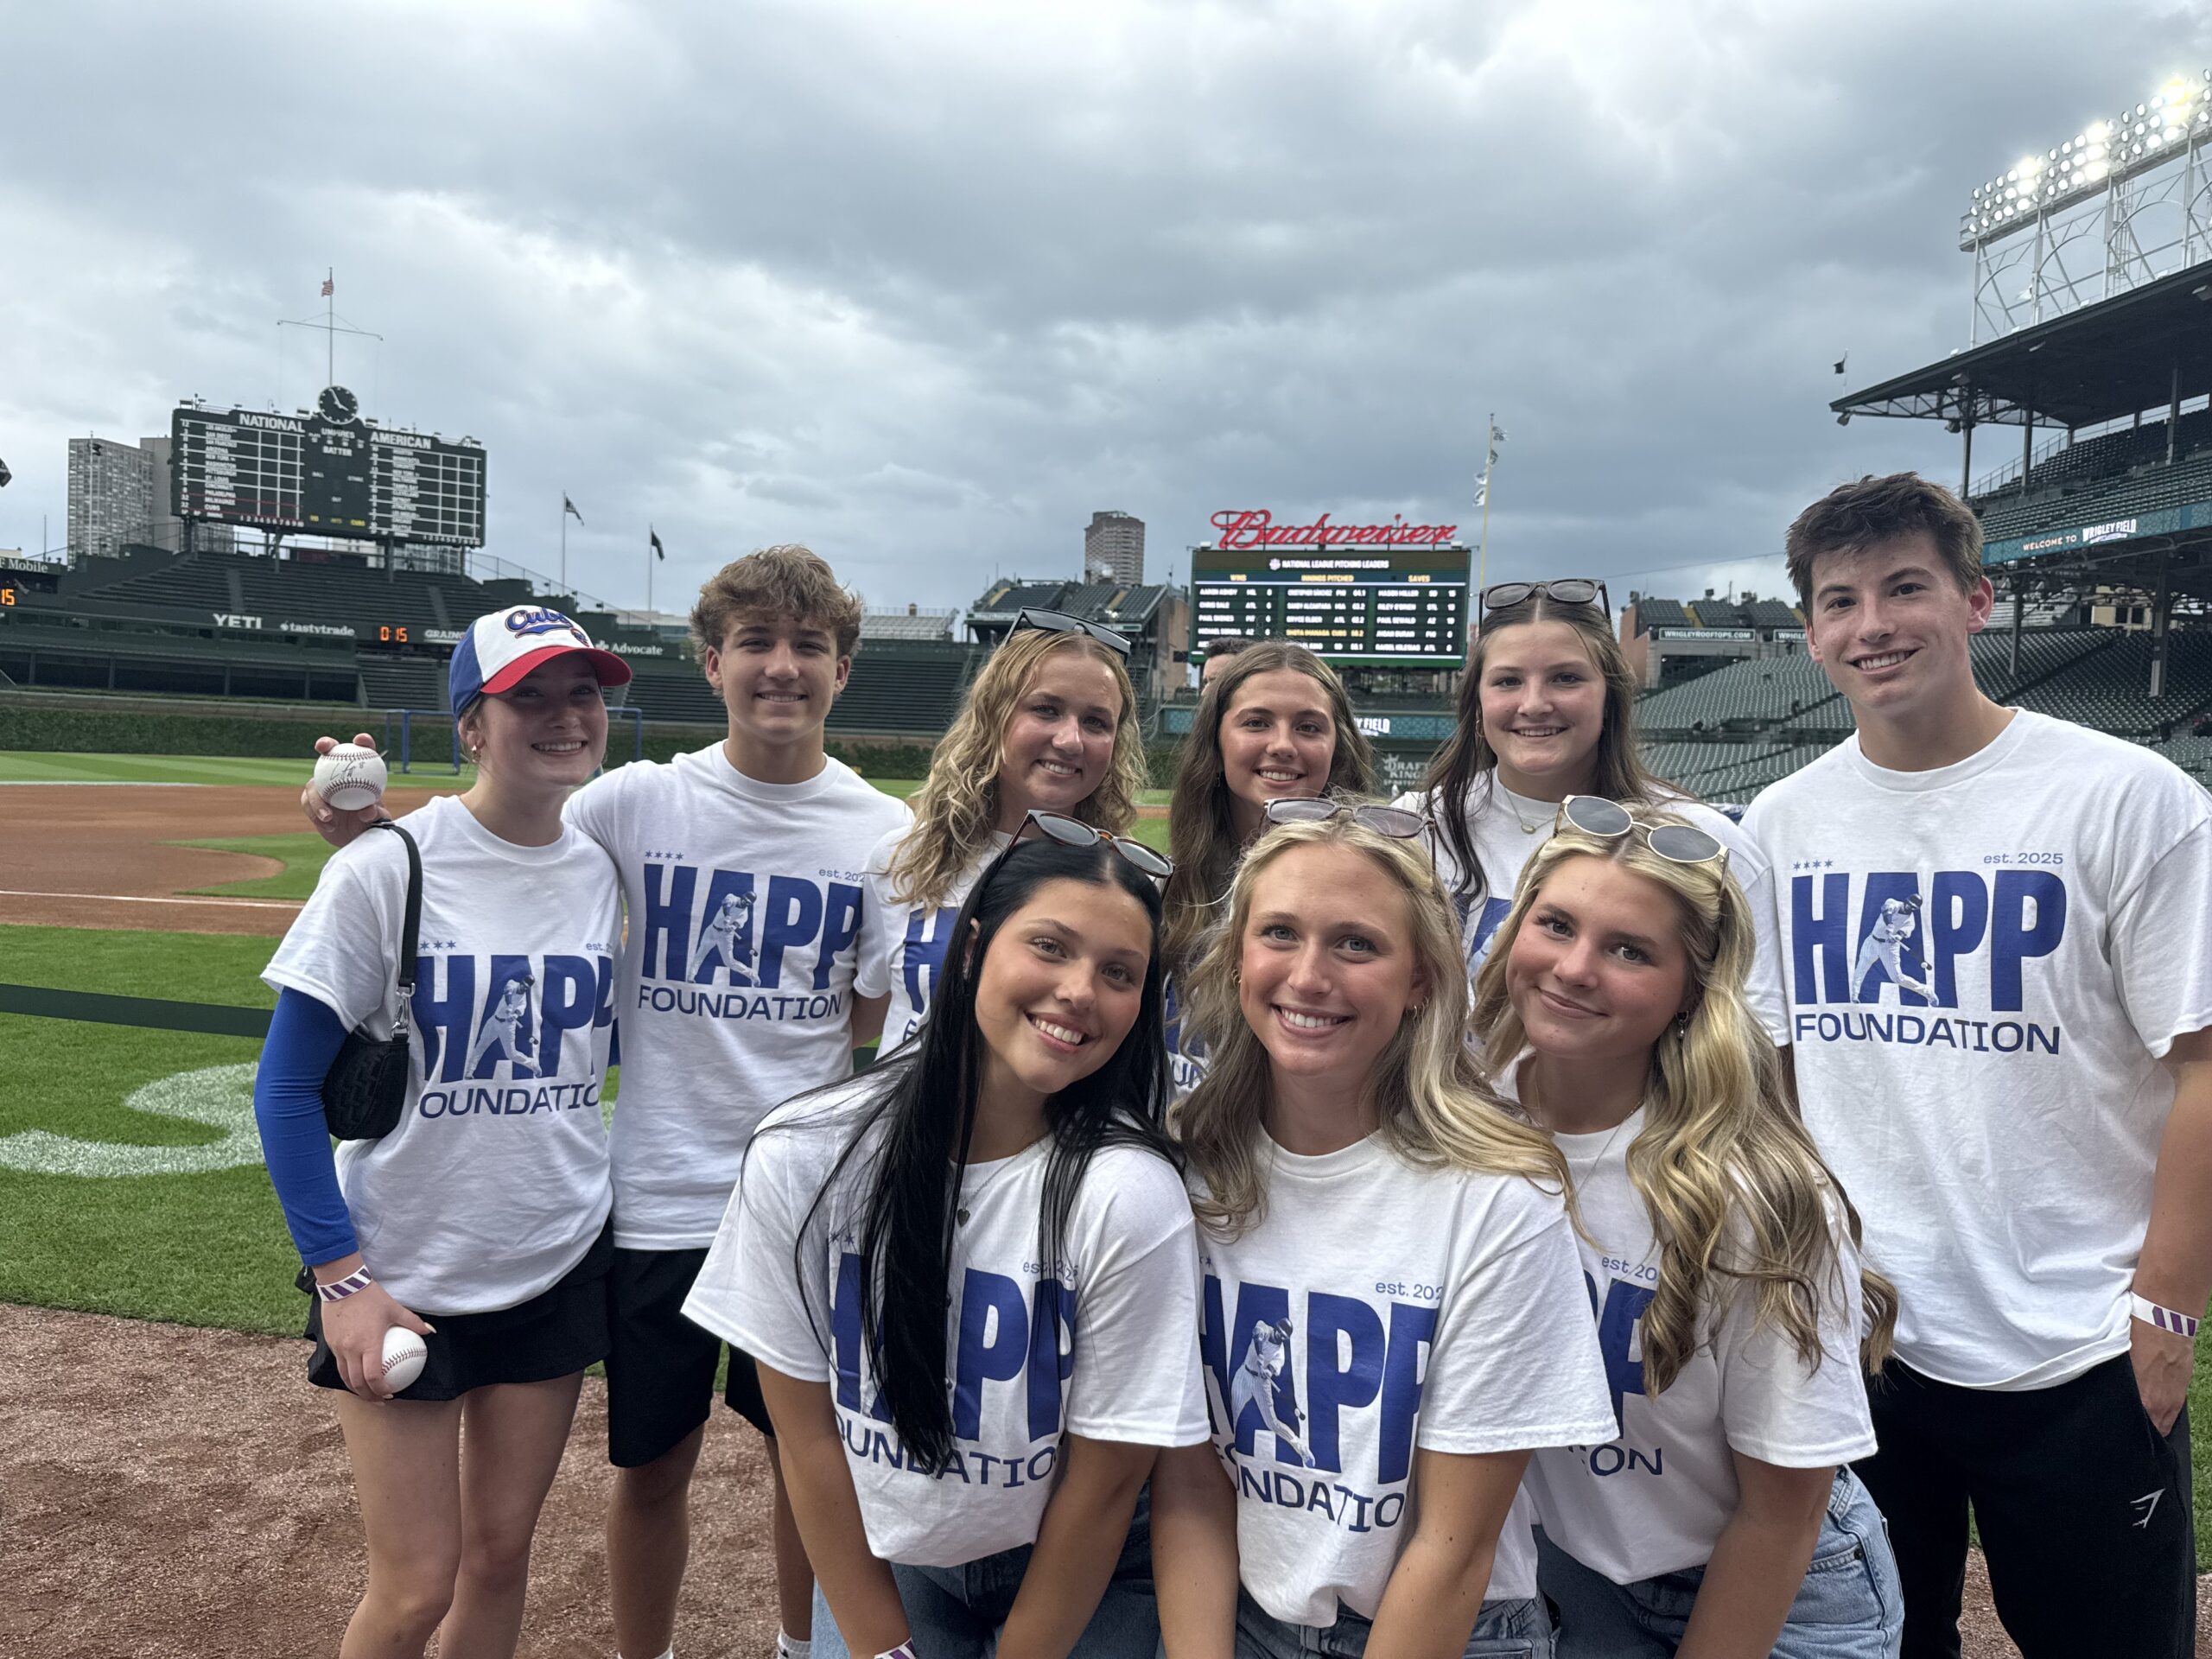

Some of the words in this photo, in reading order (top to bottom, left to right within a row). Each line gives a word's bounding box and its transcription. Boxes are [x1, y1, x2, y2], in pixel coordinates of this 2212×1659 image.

[239, 413, 305, 433] NATIONAL
[370, 431, 431, 449] AMERICAN
[322, 446, 353, 457] BATTER
[1211, 509, 1457, 550] Budweiser
[2023, 537, 2063, 551] WELCOME
[2065, 534, 2077, 543] TO
[2082, 522, 2115, 542] WRIGLEY
[2116, 518, 2137, 533] FIELD
[8, 558, 48, 574] Mobile
[1, 588, 15, 606] 15
[213, 613, 262, 629] YETI
[289, 622, 355, 637] tastytrade
[379, 626, 408, 642] 0:15
[1664, 630, 1751, 639] WRIGLEYROOFTOPS.COM
[612, 643, 663, 656] Advocate
[1363, 717, 1390, 734] FIELD
[1984, 854, 2012, 865] est.
[2018, 852, 2063, 865] 2025
[818, 867, 842, 880] est.
[844, 870, 865, 883] 202
[642, 862, 863, 991] HAPP
[586, 941, 603, 951] est.
[1791, 869, 2067, 1012] HAPP
[638, 984, 842, 1021] FOUNDATION
[1795, 1012, 2060, 1055] FOUNDATION
[419, 1082, 599, 1119] OUNDATIO
[1601, 1256, 1630, 1274] est.
[1634, 1264, 1657, 1281] 20
[1376, 1281, 1409, 1297] est.
[1413, 1284, 1442, 1300] 202
